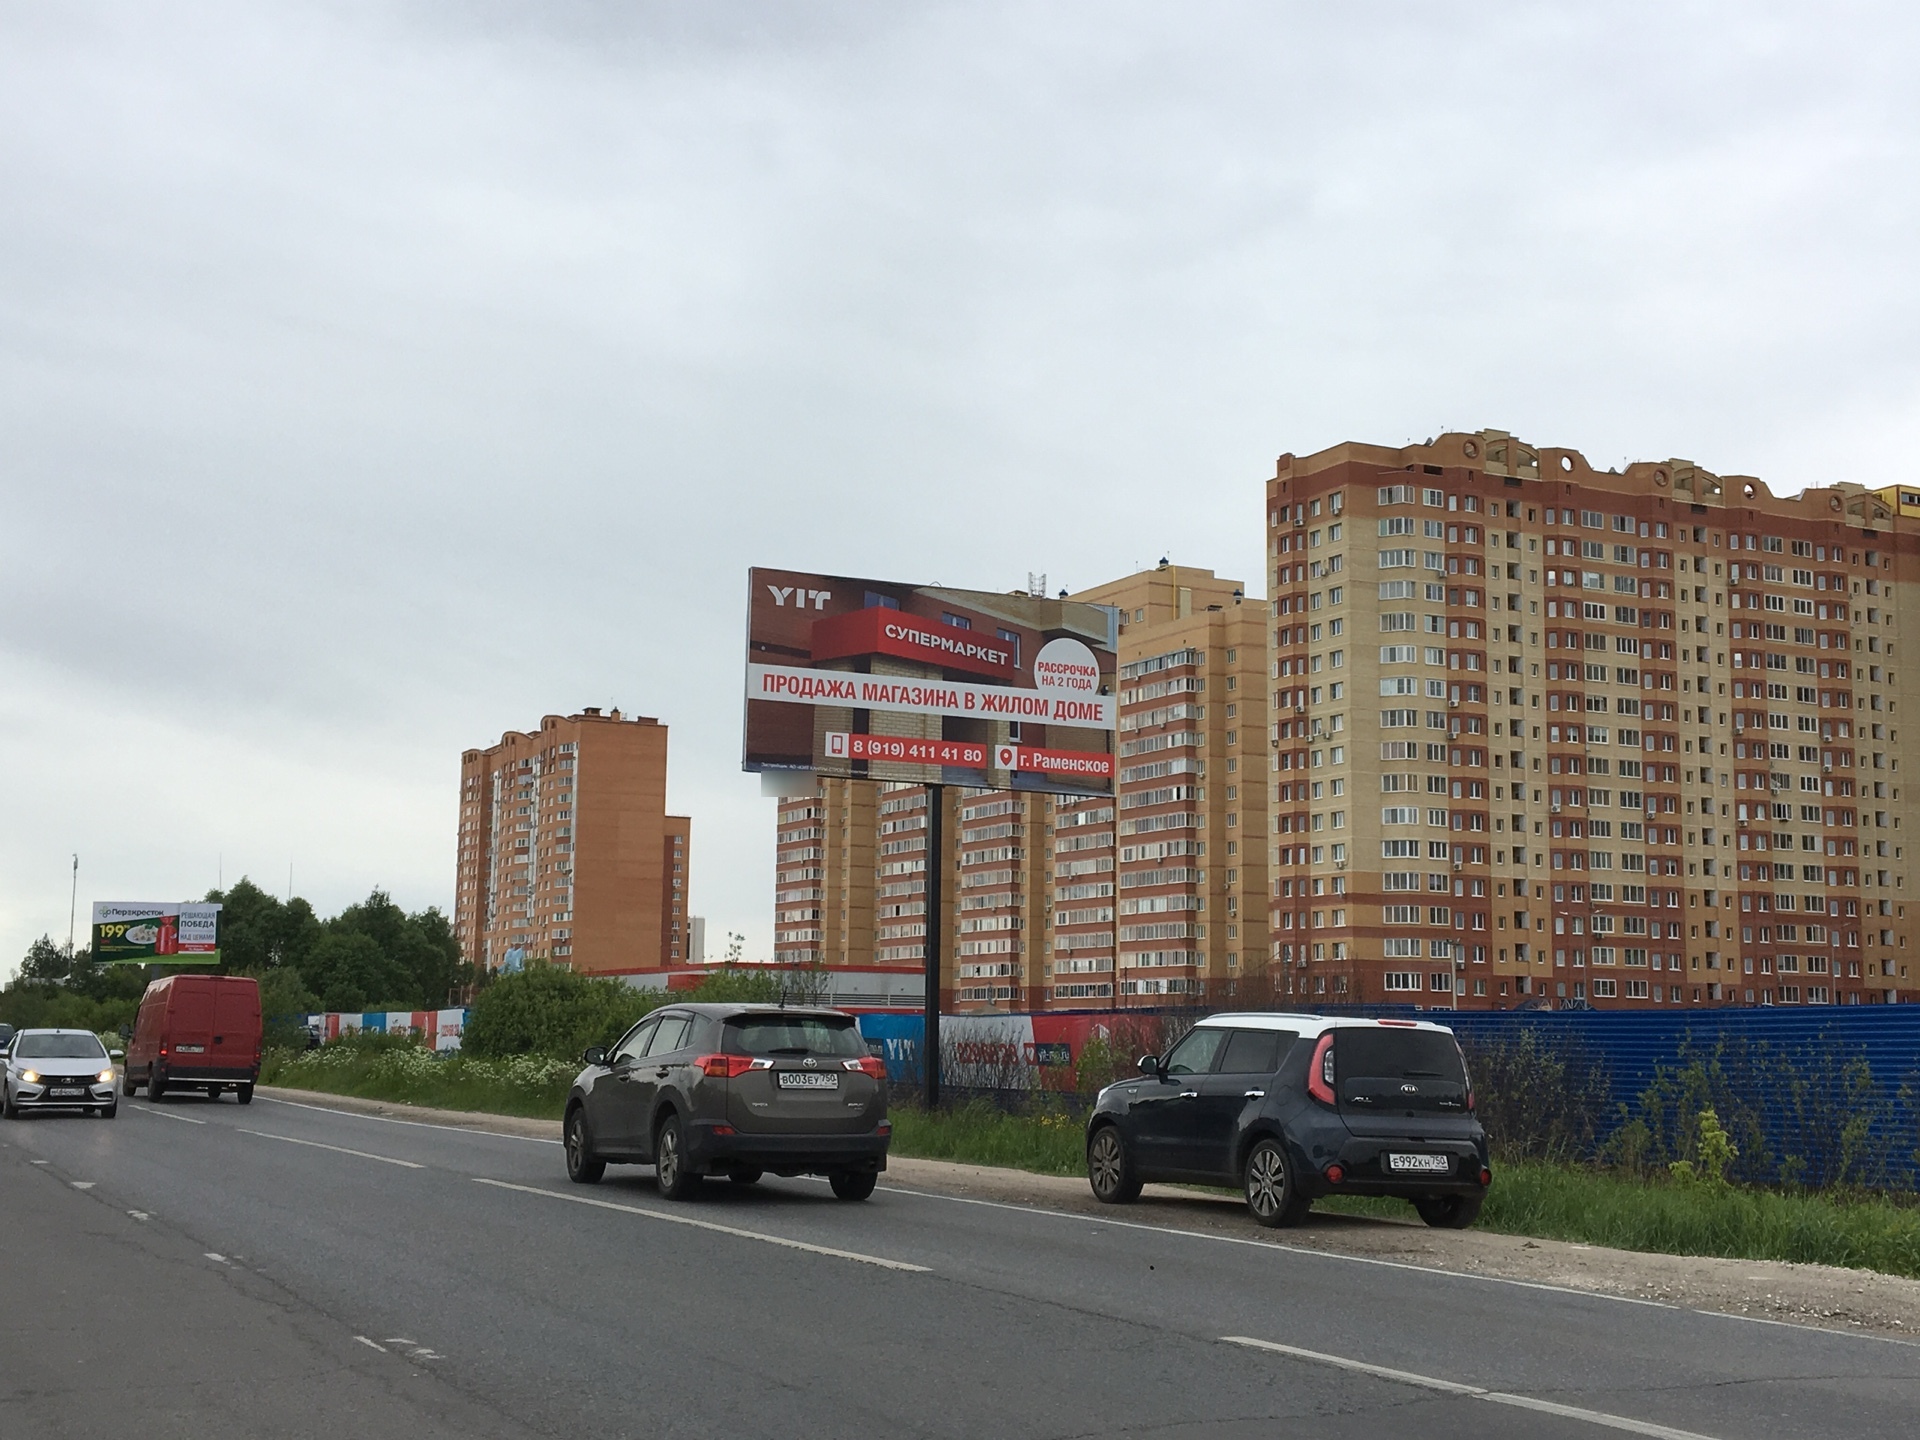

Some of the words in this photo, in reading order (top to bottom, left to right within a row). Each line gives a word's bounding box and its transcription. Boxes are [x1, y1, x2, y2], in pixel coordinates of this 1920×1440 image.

[767, 585, 831, 610] YIT
[885, 624, 1008, 665] СУПЕРМАРКЕТ
[1038, 662, 1096, 677] РАССРОЧКА
[1042, 675, 1055, 686] НА
[1057, 677, 1064, 687] 2
[1066, 678, 1092, 691] ГОДА
[763, 674, 857, 699] ПРОДАЖА
[863, 683, 959, 709] МАГАЗИНА
[964, 692, 976, 710] В
[981, 694, 1049, 716] ЖИЛОМ
[1053, 700, 1103, 721] ДОМЕ
[853, 740, 863, 753] 8
[867, 740, 905, 758] (919)
[909, 745, 936, 759] 411
[941, 747, 958, 760] 41
[963, 749, 982, 762] 80
[1020, 755, 1029, 767] г.
[1033, 755, 1109, 773] Раменское
[100, 924, 124, 938] 199
[181, 921, 215, 929] ПОБЕДА
[1393, 1156, 1431, 1169] Е992КН
[1431, 1156, 1444, 1165] 750
